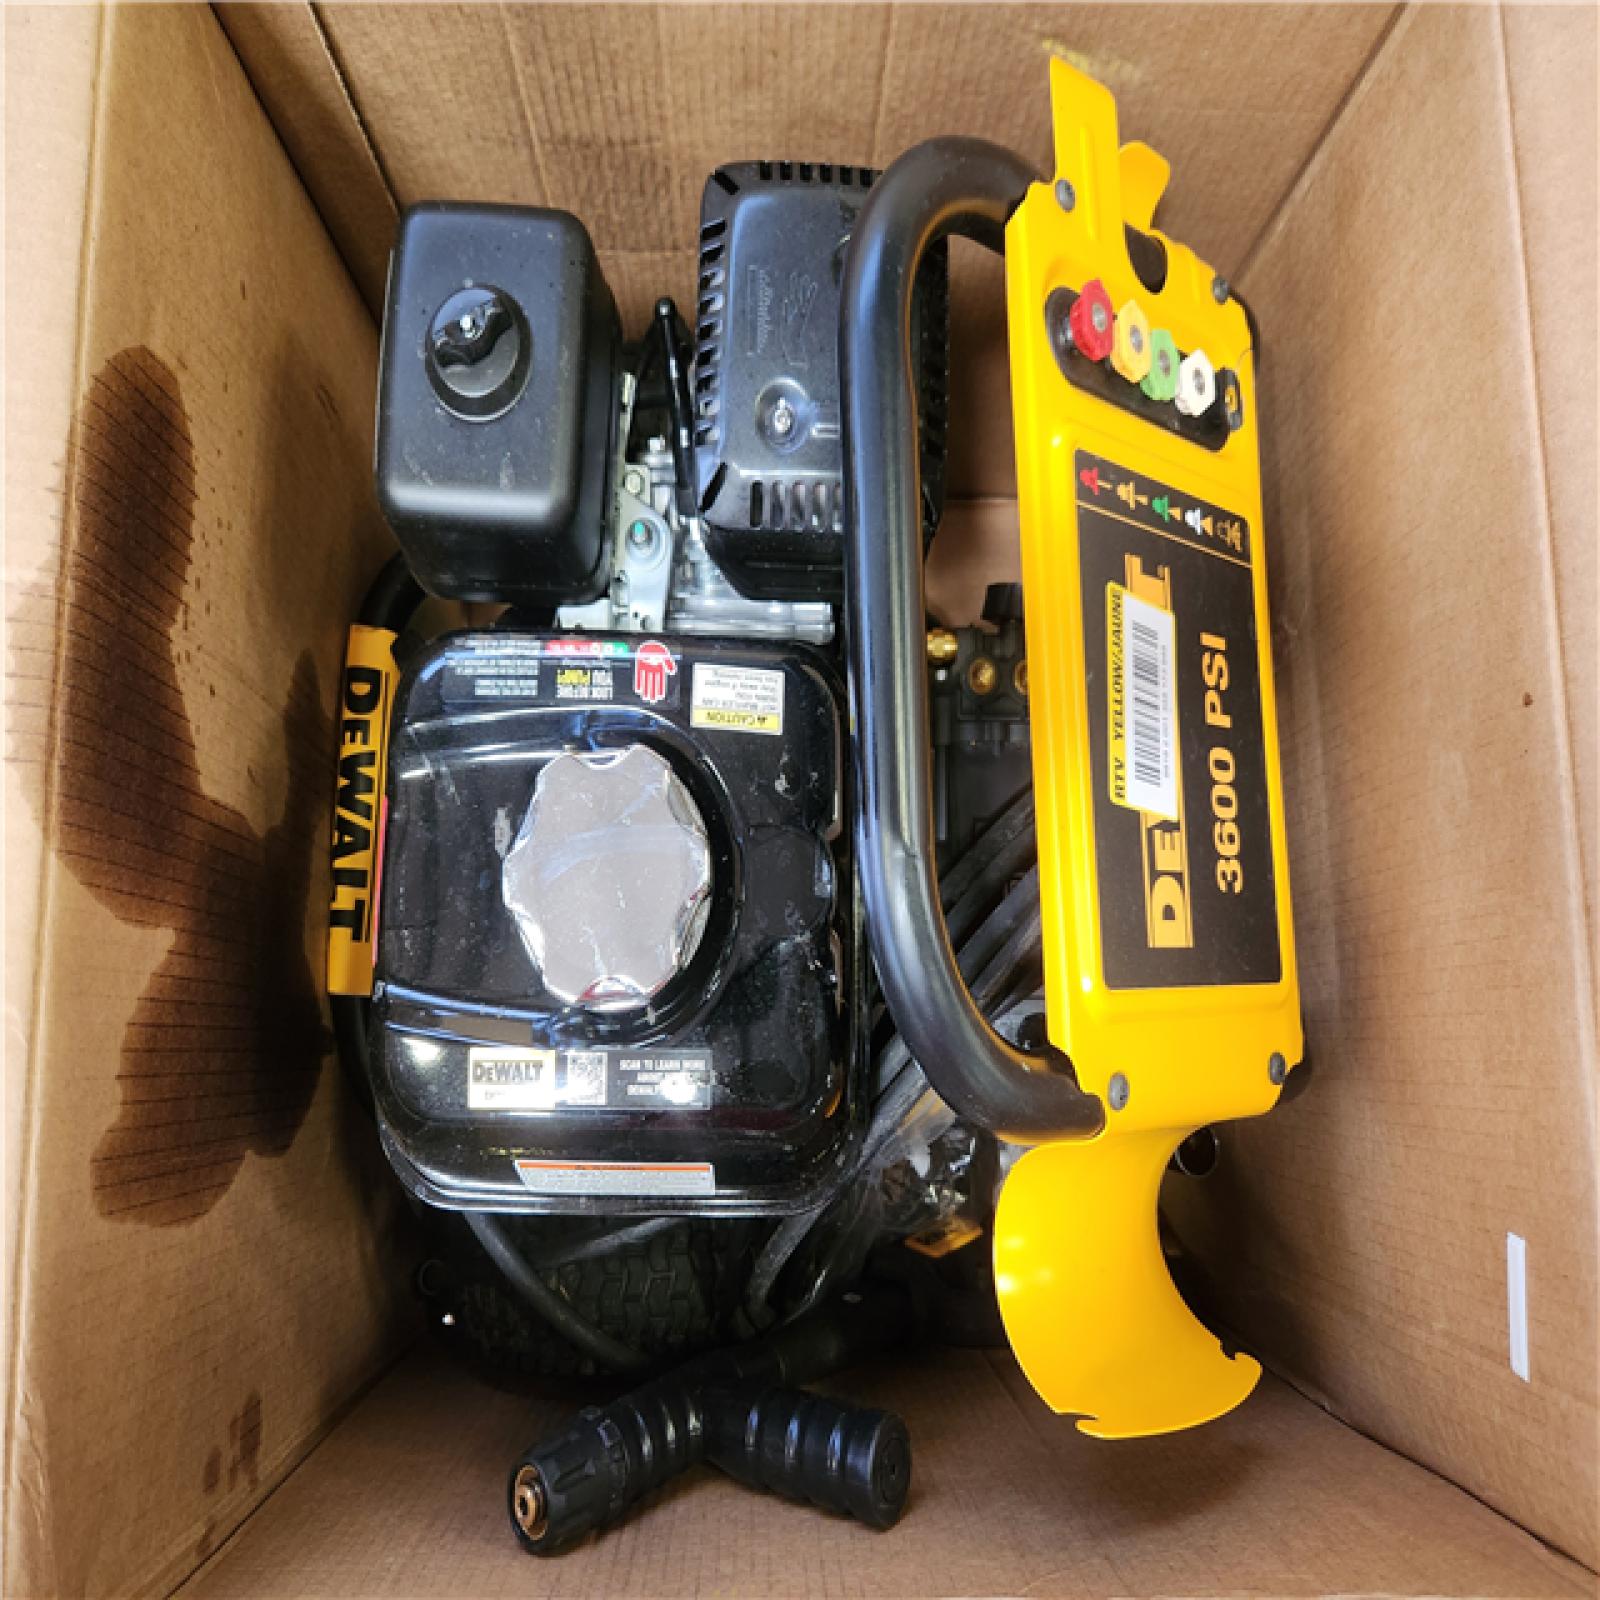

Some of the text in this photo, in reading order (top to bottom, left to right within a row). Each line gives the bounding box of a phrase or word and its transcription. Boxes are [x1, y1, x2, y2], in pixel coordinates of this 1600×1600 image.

[329, 666, 381, 942] DEWALT
[705, 711, 756, 726] CAUTION
[1112, 588, 1125, 798] RTV YELLOW/JAUNE
[1199, 631, 1243, 895] 3600 PSI
